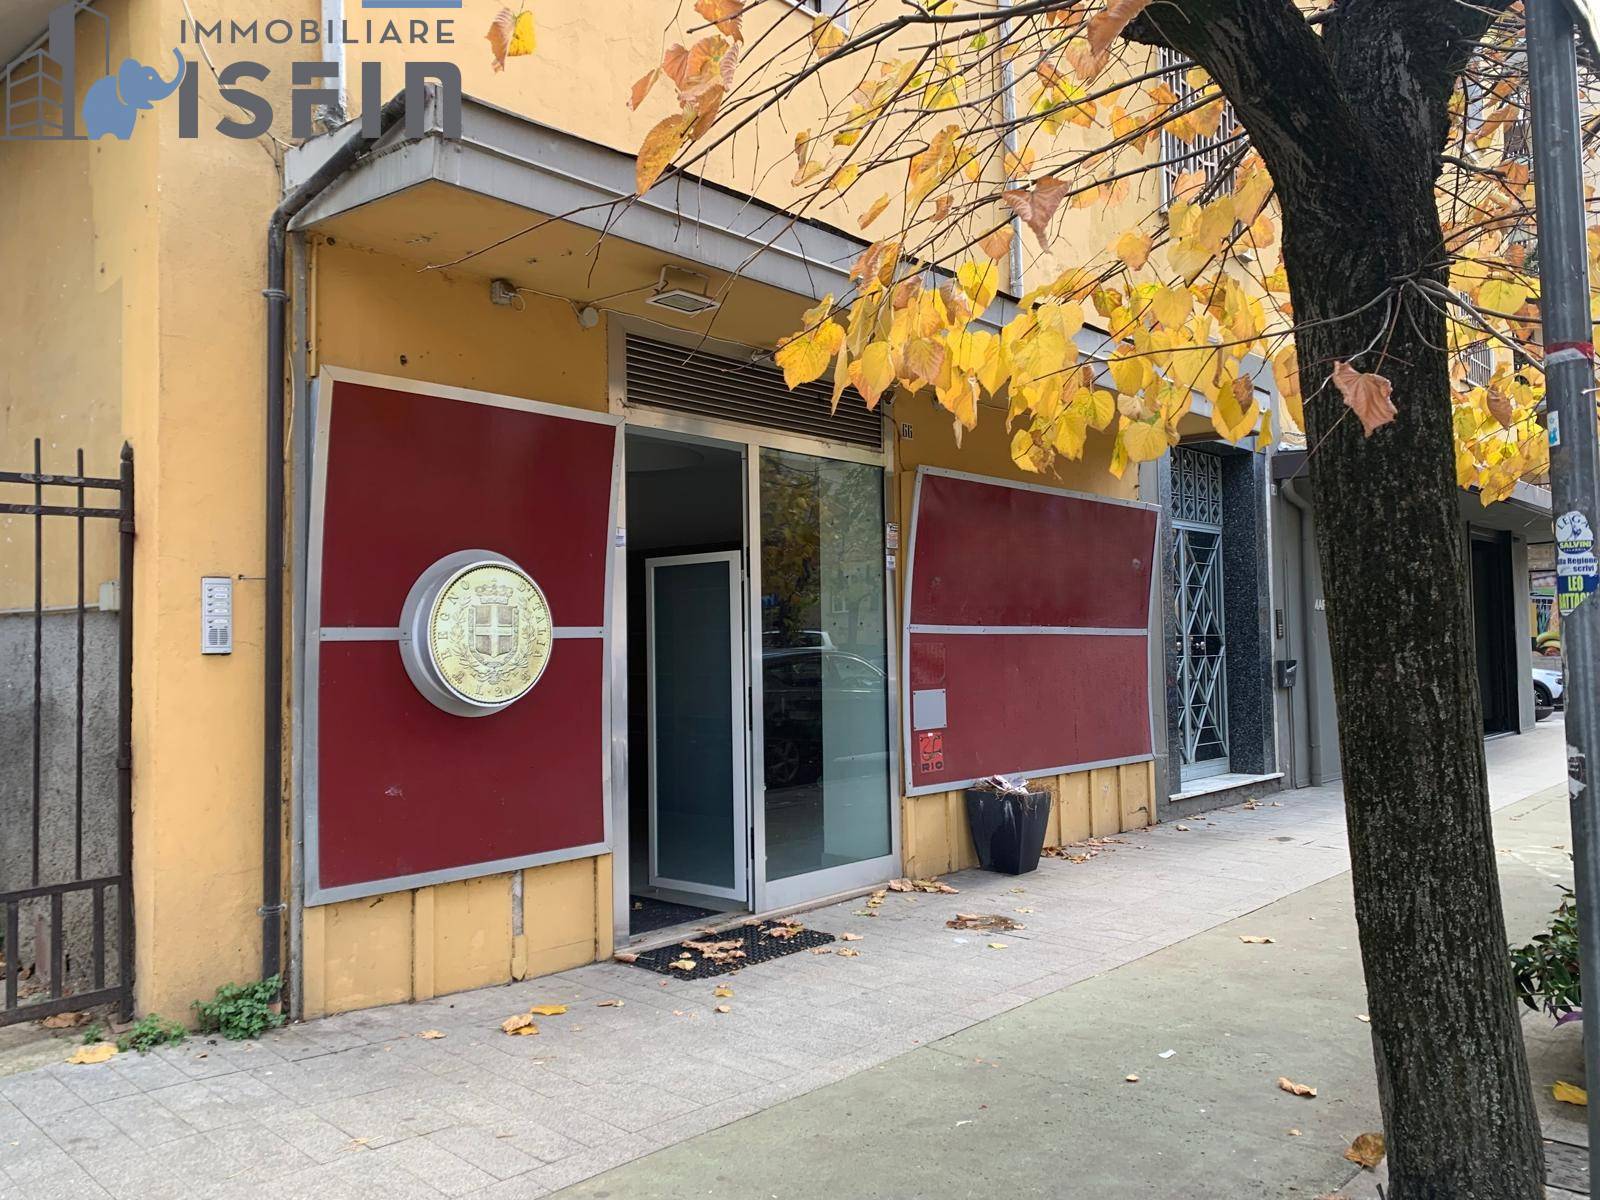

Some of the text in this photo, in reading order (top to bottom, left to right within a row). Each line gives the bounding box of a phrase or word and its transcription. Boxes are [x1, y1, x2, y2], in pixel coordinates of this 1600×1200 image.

[902, 423, 913, 439] 66
[1559, 540, 1592, 548] SALVINI
[1573, 565, 1594, 573] scrivi
[1568, 575, 1584, 592] LEO
[922, 761, 943, 771] RIO
